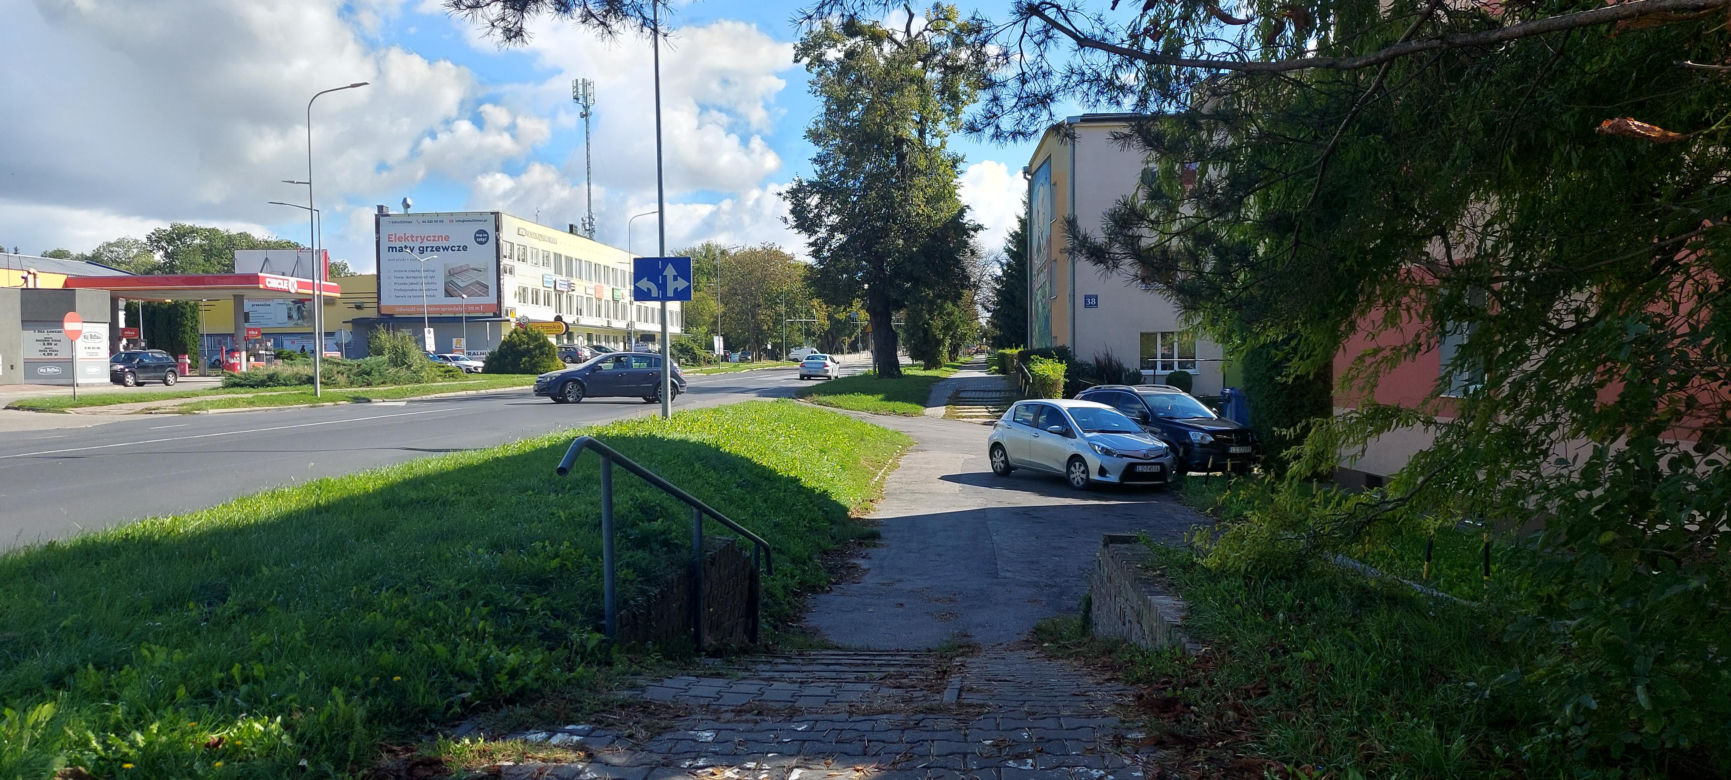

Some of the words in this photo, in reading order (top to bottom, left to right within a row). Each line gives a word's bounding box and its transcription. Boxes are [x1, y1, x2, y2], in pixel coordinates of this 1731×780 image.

[387, 234, 450, 244] Elektryczne
[387, 244, 415, 253] maty
[418, 244, 468, 254] grzewcze
[266, 278, 289, 289] CIRCLE
